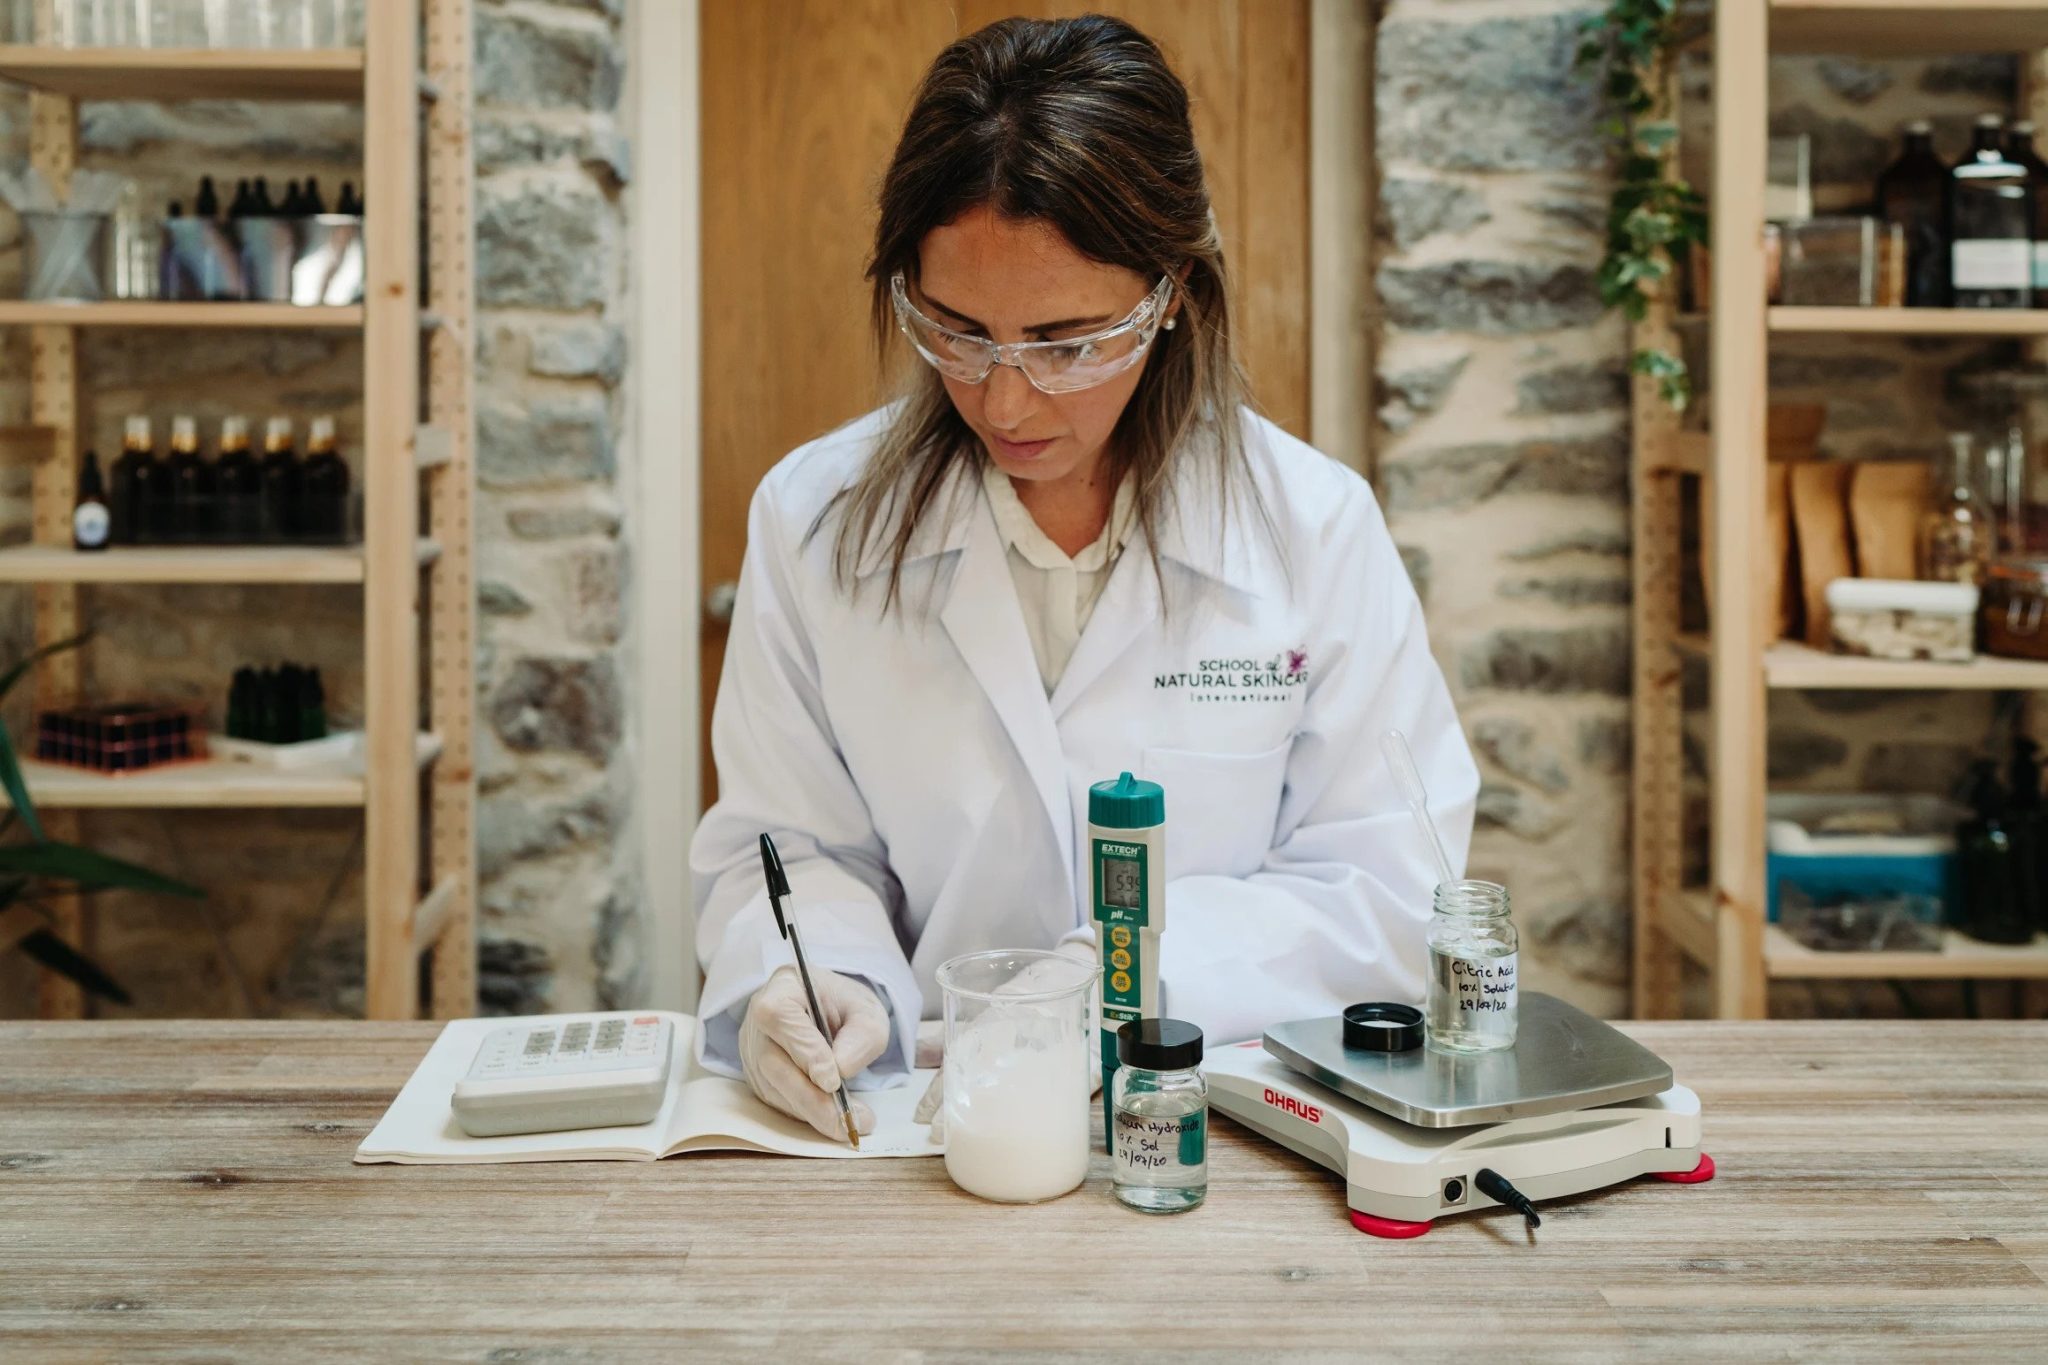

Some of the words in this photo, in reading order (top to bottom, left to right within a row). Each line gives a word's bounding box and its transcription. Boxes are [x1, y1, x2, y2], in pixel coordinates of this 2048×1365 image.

[1199, 660, 1261, 672] SCHOOL
[1154, 674, 1237, 688] NATURAL
[1101, 843, 1138, 855] EXTECH
[1452, 961, 1493, 977] Citric
[1264, 1088, 1320, 1123] OHAUS
[1148, 1120, 1200, 1135] Hydroxide
